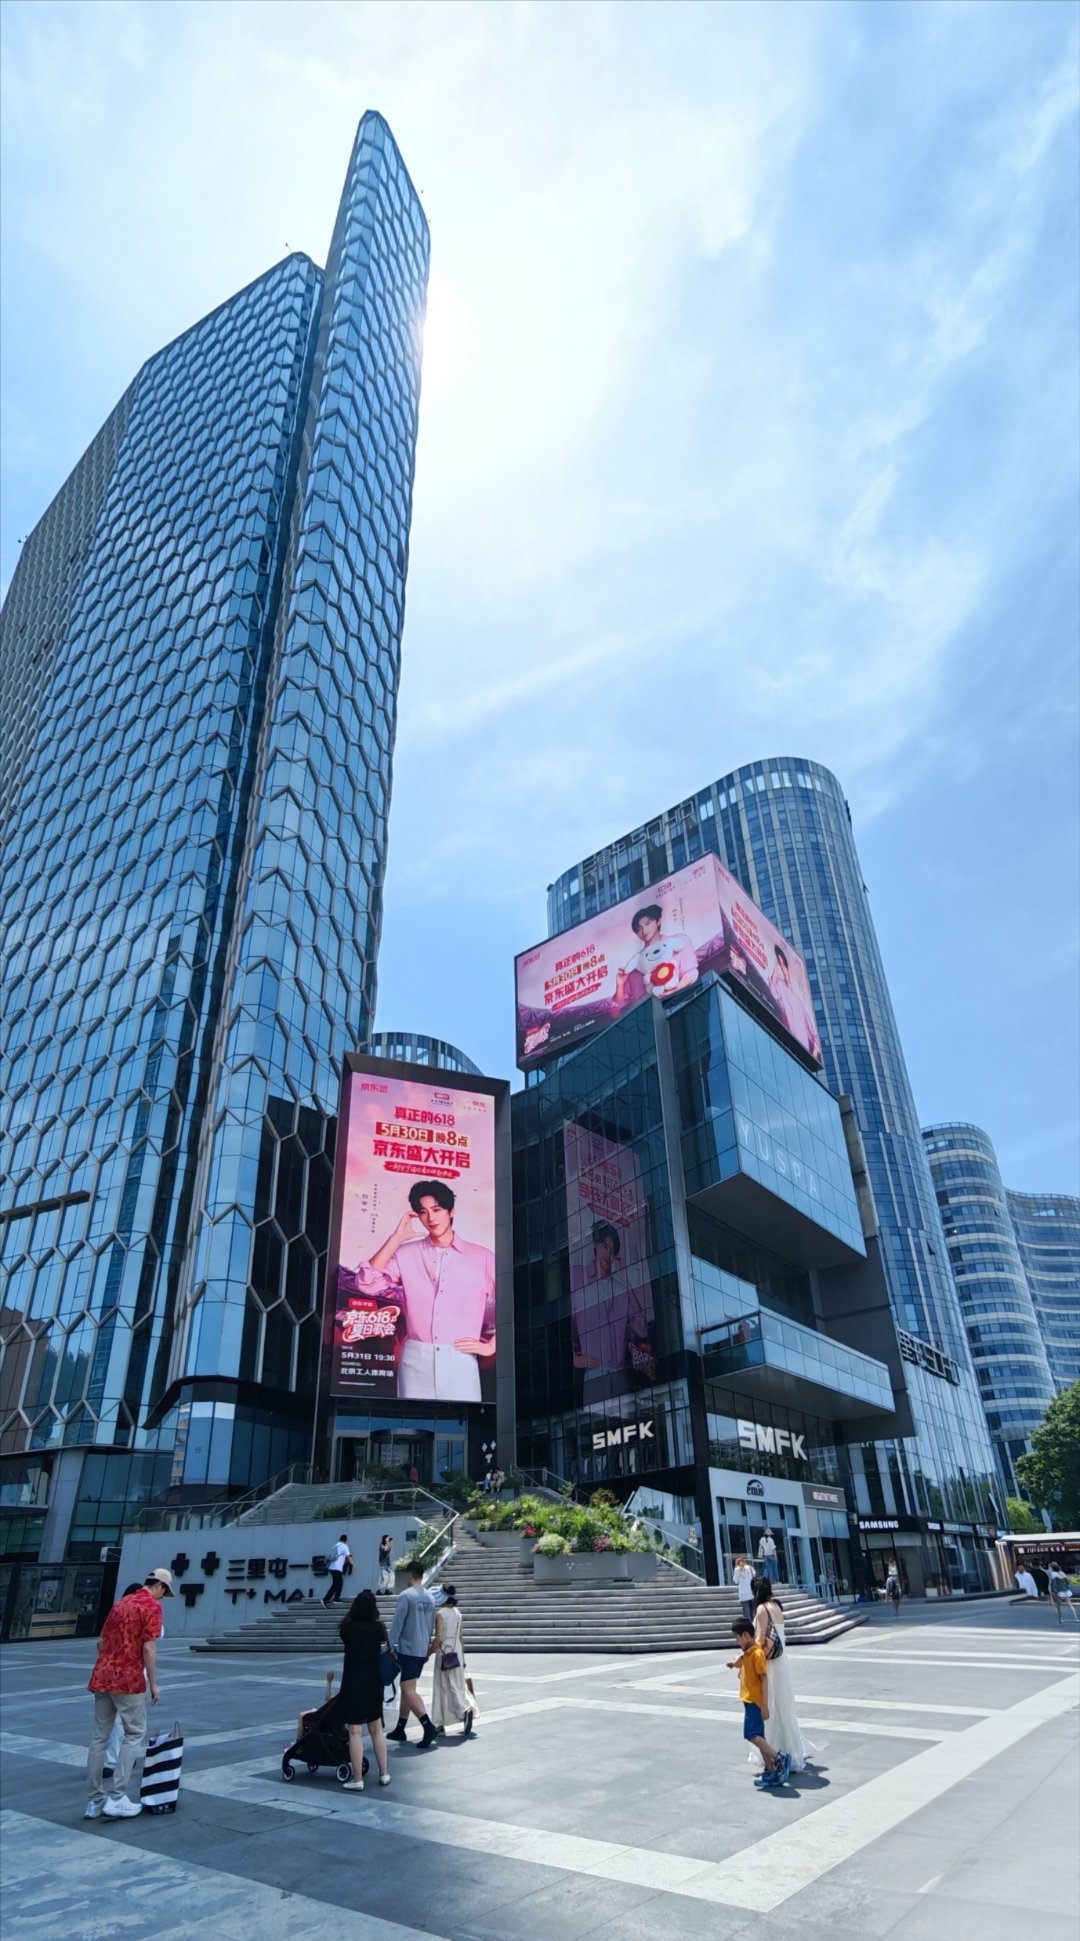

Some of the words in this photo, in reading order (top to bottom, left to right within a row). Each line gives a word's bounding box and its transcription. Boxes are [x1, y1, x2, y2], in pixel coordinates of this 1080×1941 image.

[544, 965, 608, 1006] 京东盛大开启
[395, 1105, 455, 1126] 真正的618
[381, 1123, 428, 1141] 5月30日
[435, 1131, 468, 1147] 晚8点
[373, 1140, 470, 1168] 京东盛大开启
[349, 1323, 396, 1339] 夏日歌会
[341, 1351, 372, 1360] 5月31日
[593, 1420, 654, 1450] SMFK
[737, 1418, 808, 1461] SMFK
[859, 1520, 899, 1530] SAMSUNG
[226, 1556, 353, 1580] 三里屯一号
